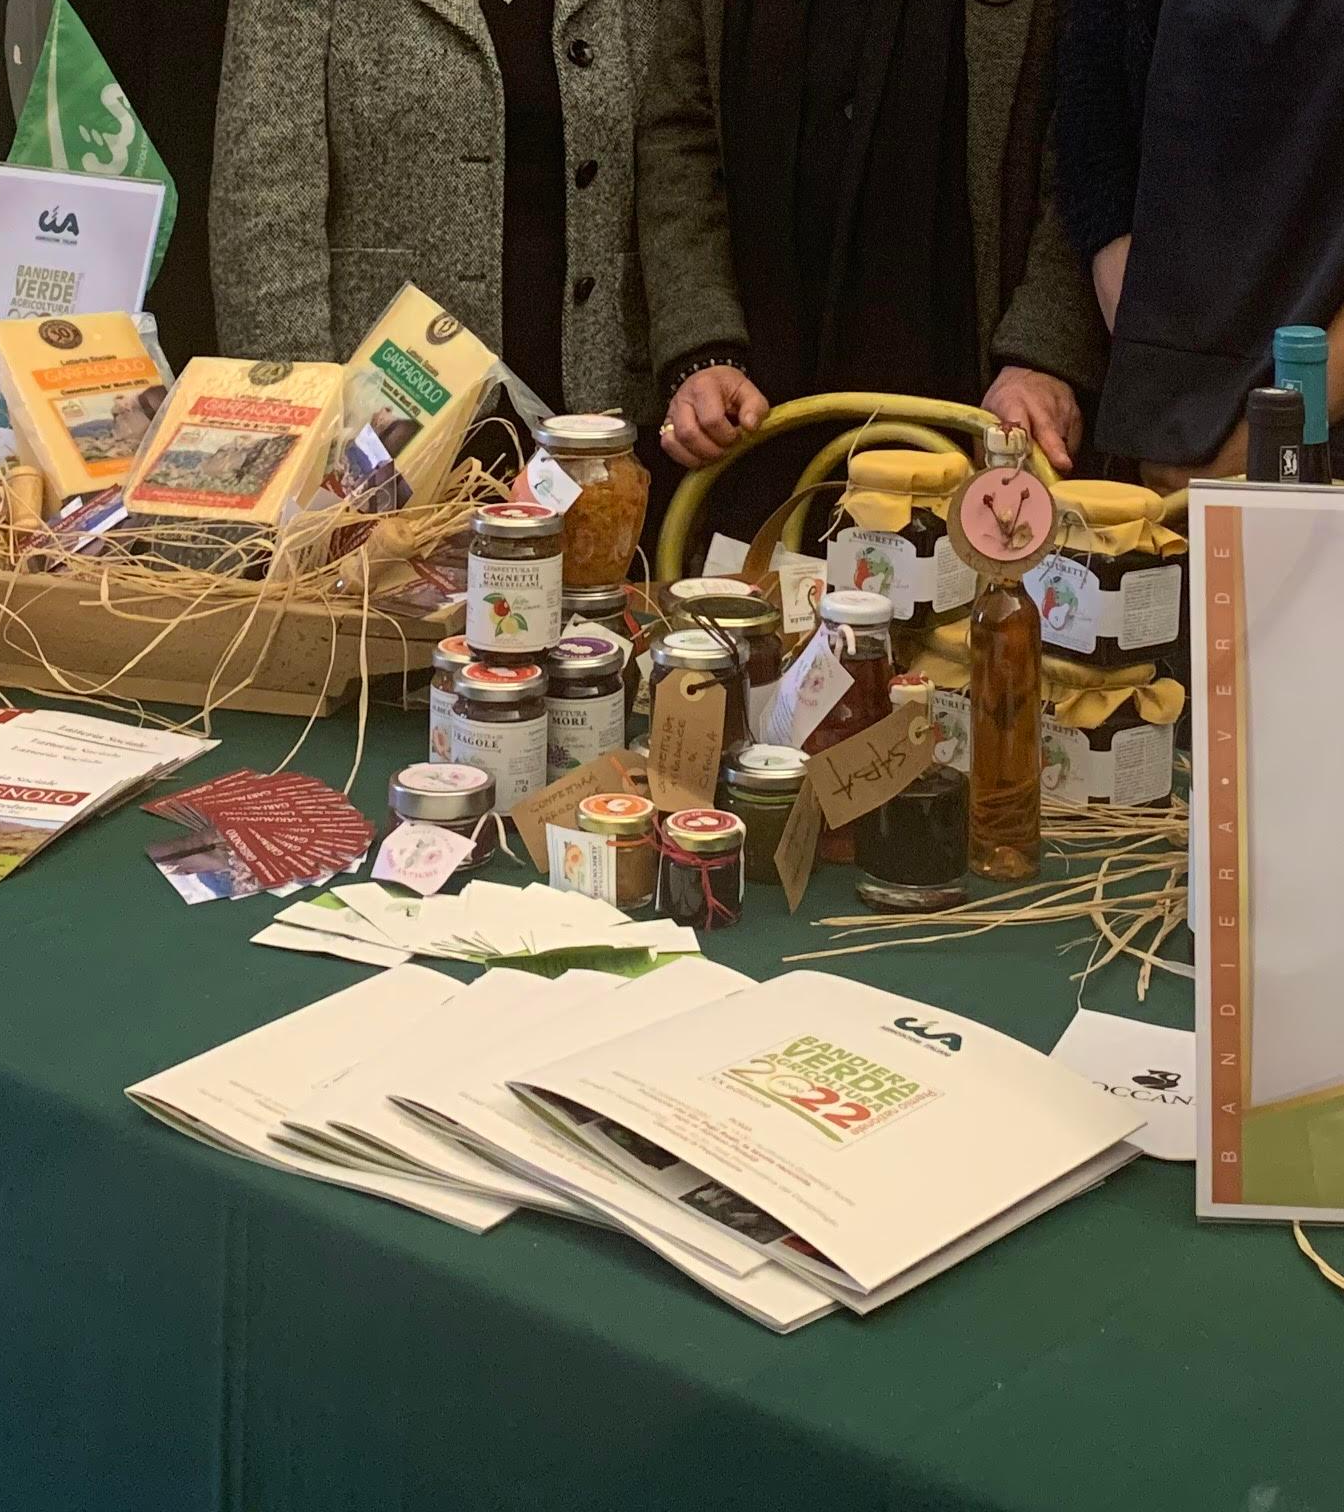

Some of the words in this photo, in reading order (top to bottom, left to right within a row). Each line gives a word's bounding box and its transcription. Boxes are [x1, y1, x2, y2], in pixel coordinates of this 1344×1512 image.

[17, 264, 76, 284] BANDIERA
[15, 277, 75, 304] VERDE
[11, 297, 70, 315] AGRICOLTURA
[44, 360, 146, 383] GARFAGNOLO
[382, 347, 443, 403] GARFAGNOLO
[204, 399, 309, 419] GARFAGNOLO
[483, 573, 539, 583] CAGNETTI
[1214, 544, 1233, 742] VERDE
[552, 716, 588, 727] MORE
[1217, 820, 1238, 1164] BANDIERA
[782, 1042, 909, 1106] VERDE
[798, 1036, 920, 1095] BANDIERA
[764, 1053, 884, 1112] AGRICOLTURA
[1092, 1081, 1196, 1107] CCAN
